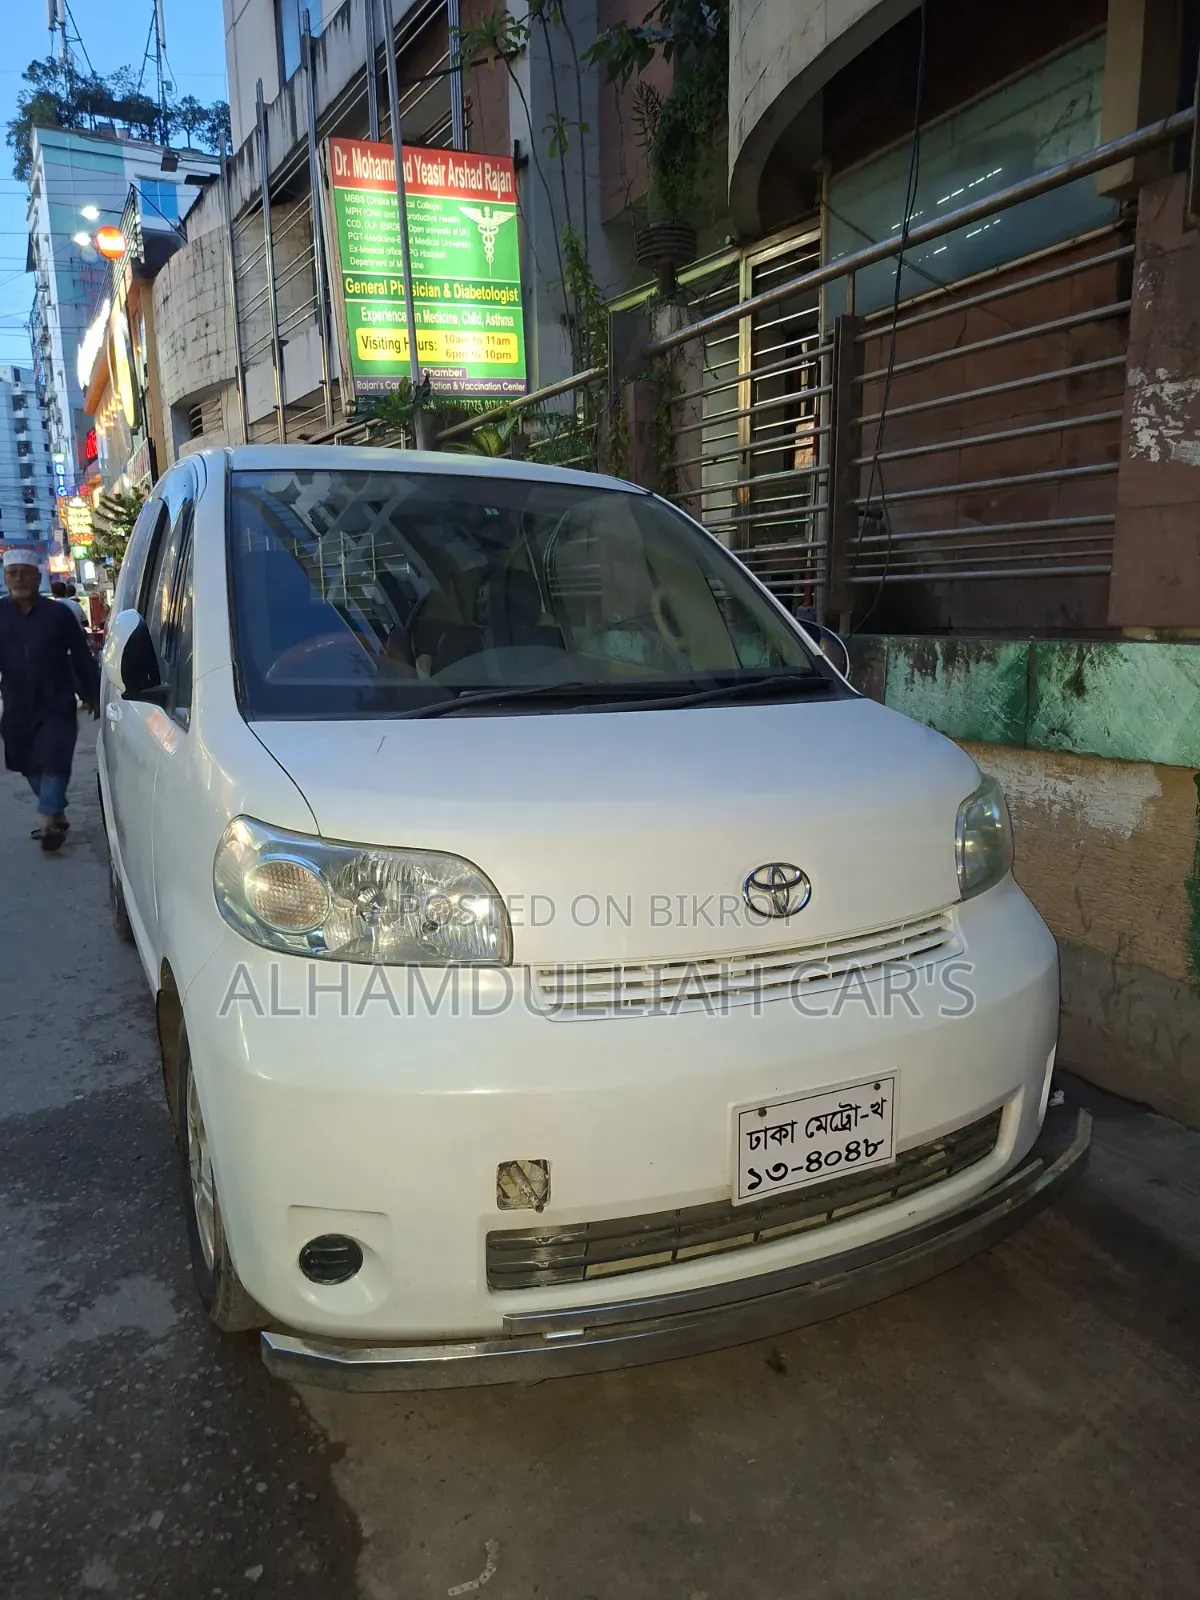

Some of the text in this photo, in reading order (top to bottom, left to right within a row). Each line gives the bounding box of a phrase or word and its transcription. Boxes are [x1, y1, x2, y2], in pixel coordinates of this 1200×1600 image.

[334, 146, 512, 200] Dr. Mohammd Yeasir Arshad Rajan
[344, 194, 364, 204] MBBS
[345, 206, 362, 216] MPH
[384, 209, 396, 218] and
[350, 257, 388, 268] Department
[345, 278, 519, 304] General Phsician & Diabetologist
[423, 309, 460, 326] Medicine,
[462, 311, 484, 326] Child,
[486, 312, 514, 326] Asthma
[361, 334, 511, 354] Visiting Hurs: 10am to 11am
[446, 350, 468, 360] 6pm
[485, 350, 512, 361] 10pm
[422, 367, 464, 378] Chamber
[356, 380, 384, 391] Rajan's
[453, 382, 458, 390] &
[460, 382, 502, 392] Vaccination
[502, 382, 526, 392] Center
[56, 464, 68, 496] BIG
[746, 1096, 888, 1151] ঢাকা মেট্রো-খ
[747, 1138, 885, 1191] ১৩-৪০৪৮
